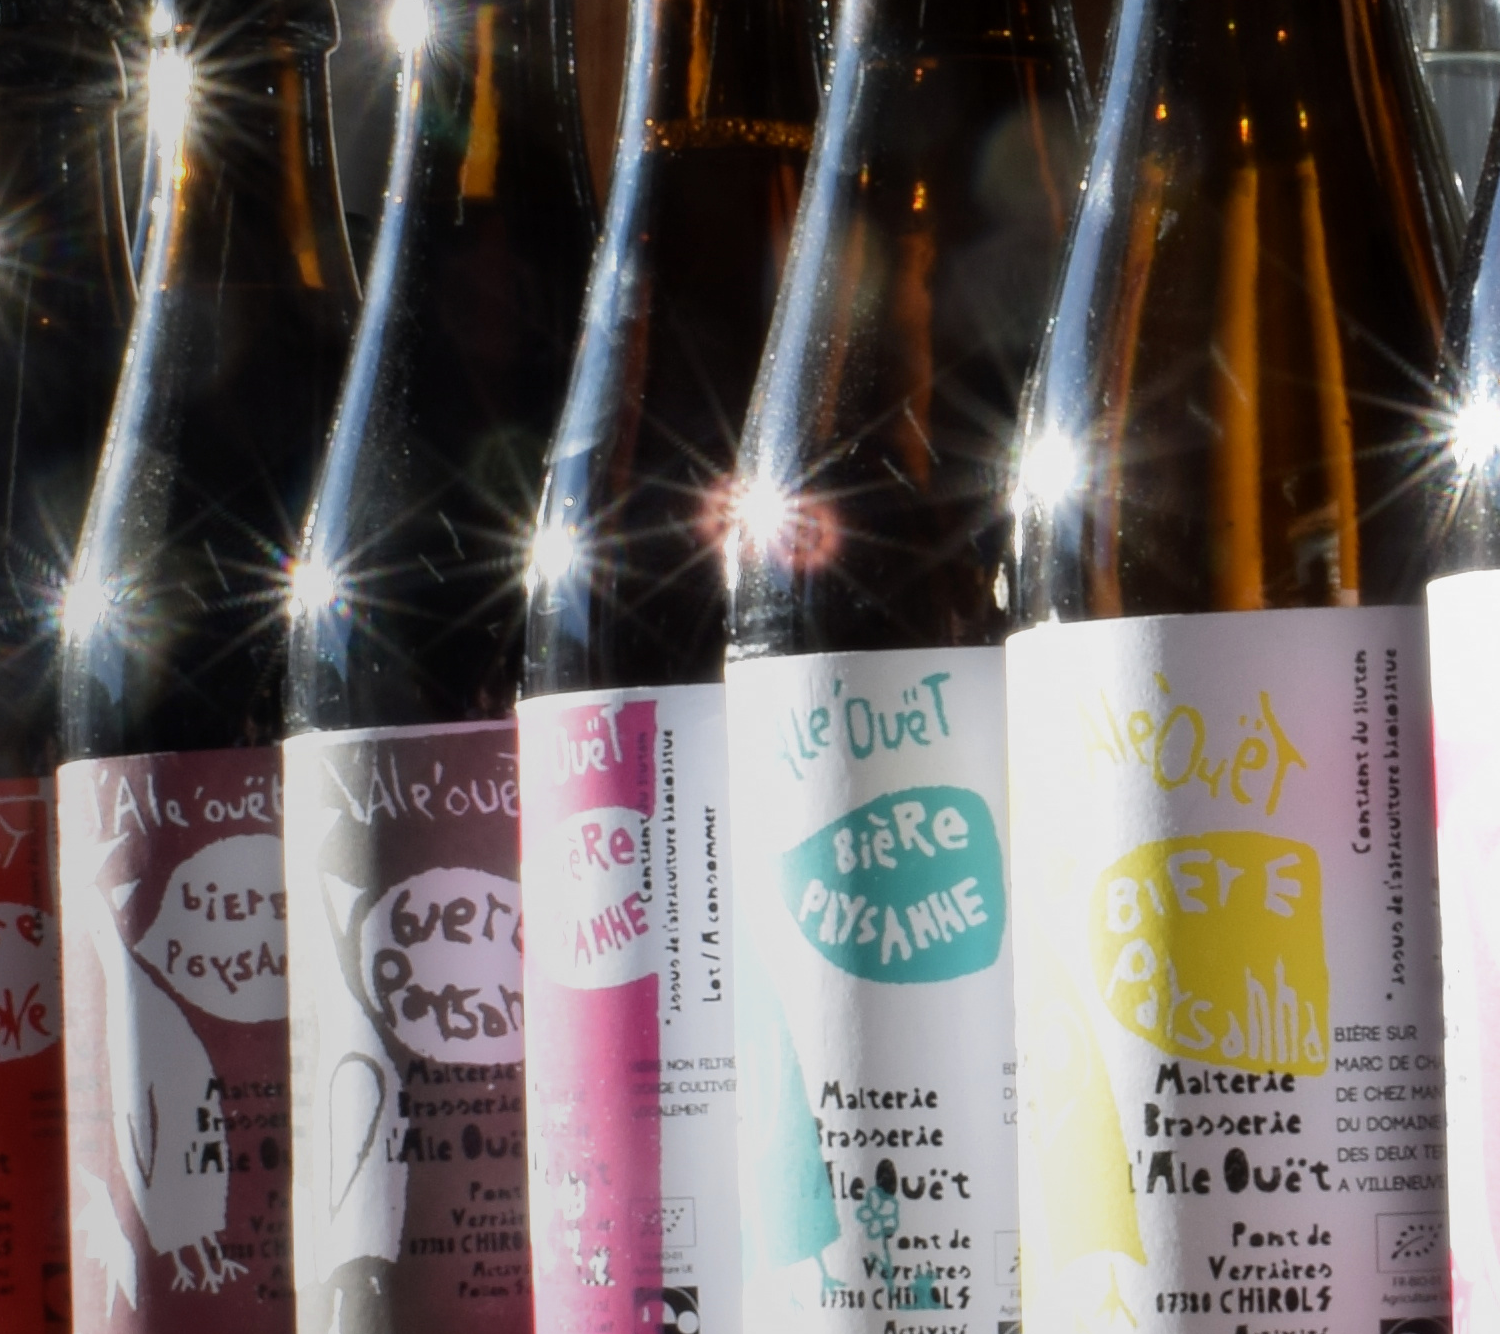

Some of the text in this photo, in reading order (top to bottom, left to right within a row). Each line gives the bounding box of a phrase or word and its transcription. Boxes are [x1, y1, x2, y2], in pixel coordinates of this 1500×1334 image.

[1352, 649, 1371, 854] Contient du gluten
[640, 818, 652, 904] Contient
[702, 805, 721, 1003] Lot A consommer
[1334, 1025, 1417, 1043] BIÈRE SUR
[406, 1063, 516, 1086] Malterie
[1335, 1056, 1409, 1072] MARC DE
[1155, 1062, 1296, 1095] Malterie
[398, 1092, 520, 1116] Brasserie
[820, 1080, 939, 1111] Malterie
[1336, 1086, 1406, 1102] DE CHEZ
[1144, 1103, 1301, 1137] Brasserie
[386, 1124, 523, 1163] l'Ale Ouë
[1338, 1146, 1417, 1163] DES DEUX
[875, 1158, 971, 1201] Ouët
[1129, 1147, 1332, 1195] l'Ale Ouët
[1338, 1177, 1350, 1193] A
[950, 1229, 971, 1249] de
[1231, 1222, 1332, 1247] Pont de
[1208, 1256, 1332, 1281] Veyrières
[1156, 1290, 1211, 1314] 07380
